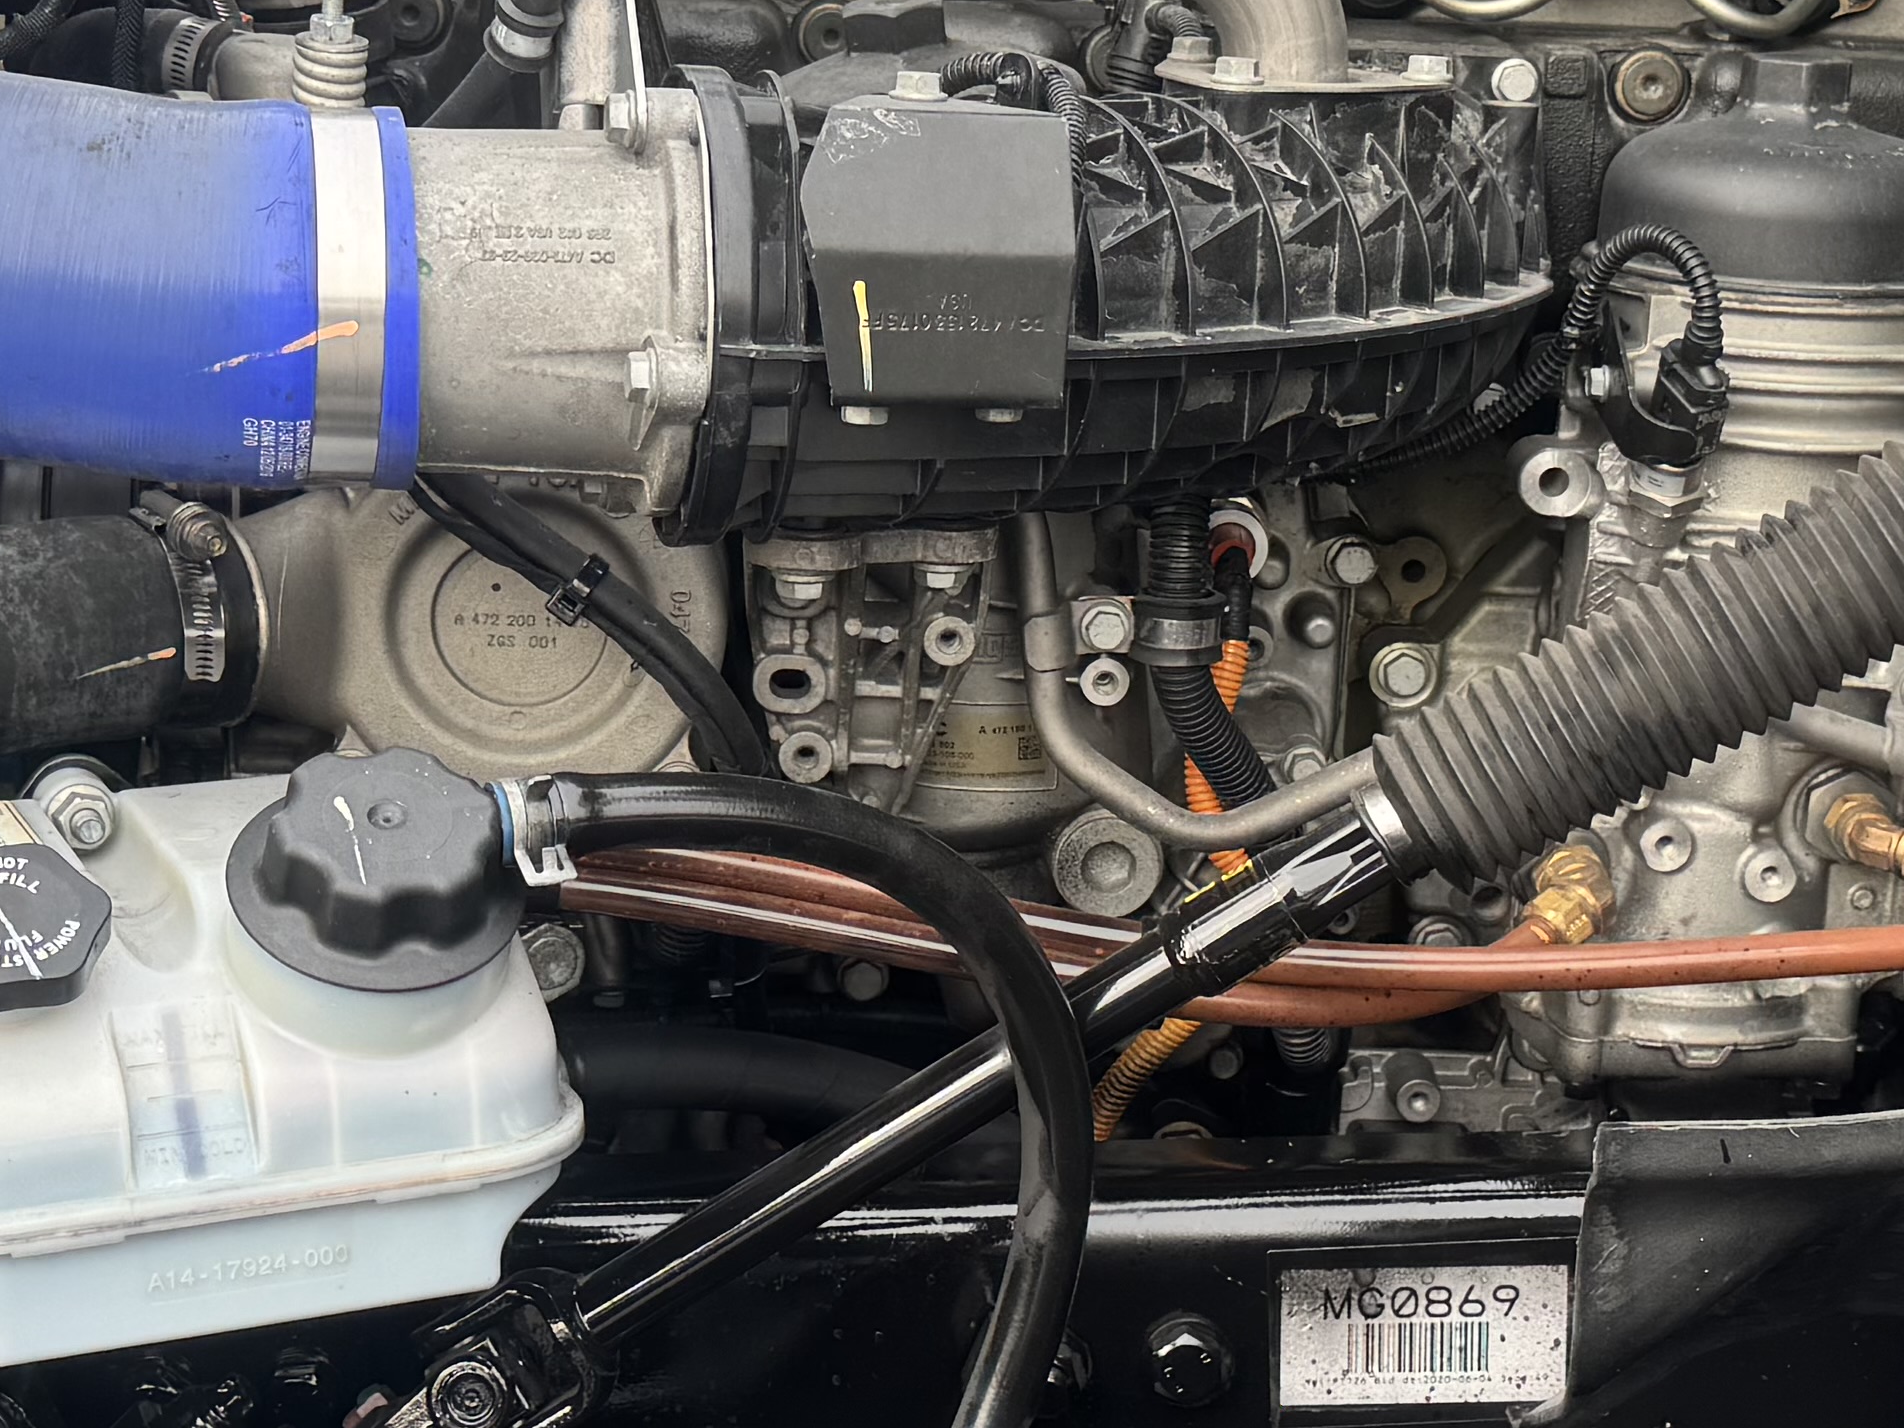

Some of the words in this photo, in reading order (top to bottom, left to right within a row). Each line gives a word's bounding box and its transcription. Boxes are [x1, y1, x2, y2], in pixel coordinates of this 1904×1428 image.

[471, 614, 499, 626] 472
[34, 920, 81, 961] POWER
[148, 1244, 348, 1292] A14-17924-000
[1323, 1284, 1520, 1320] MG0869
